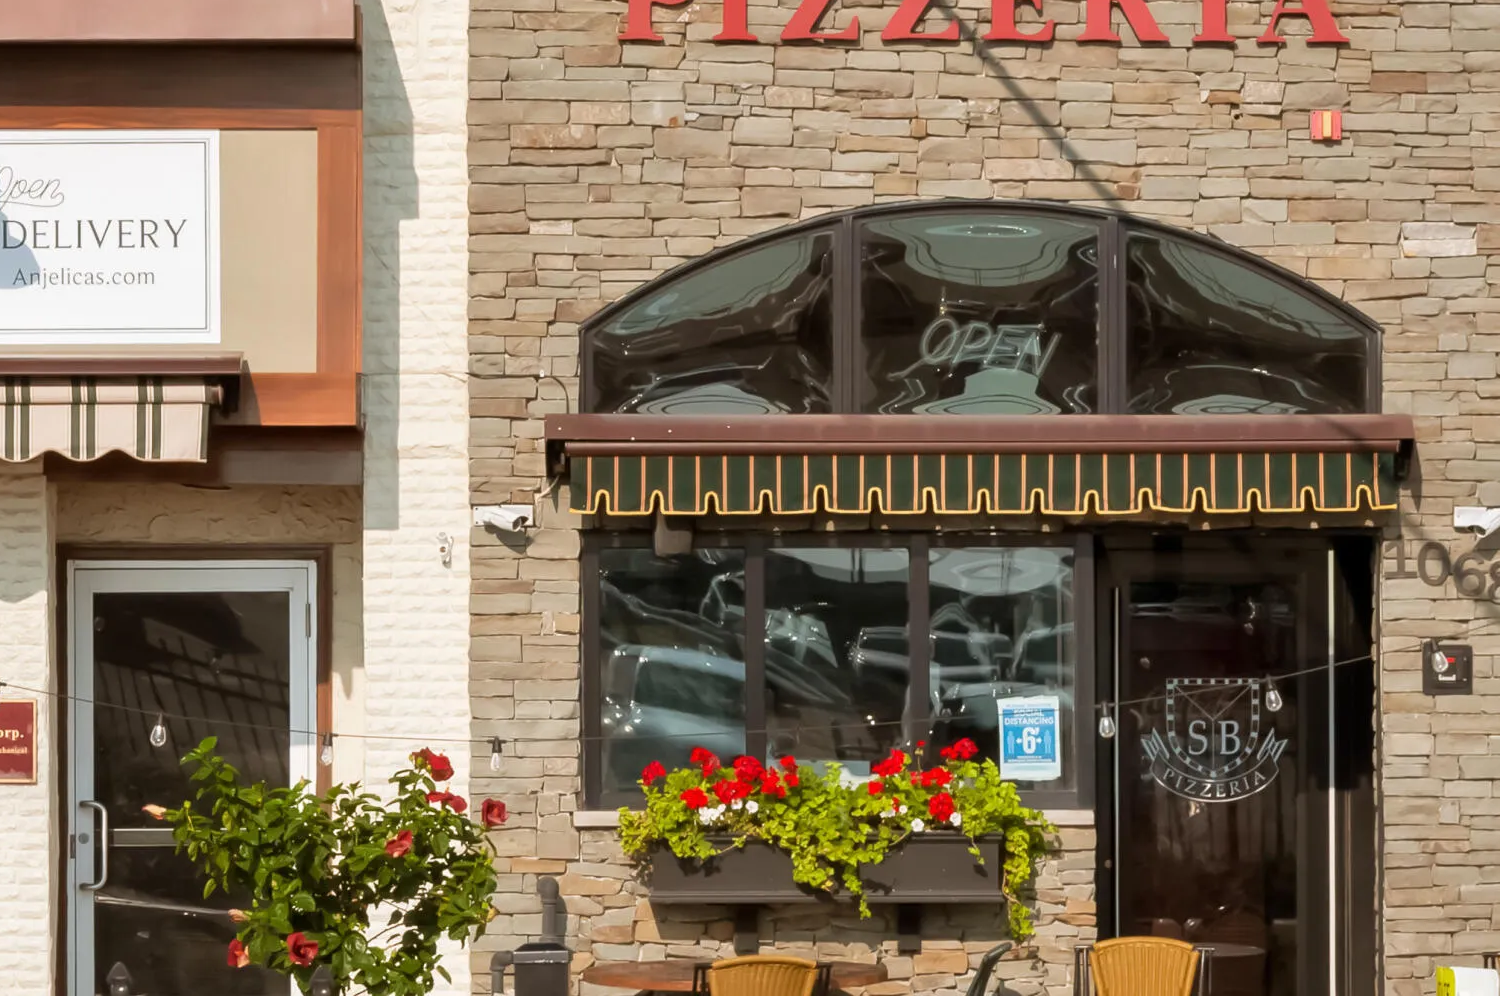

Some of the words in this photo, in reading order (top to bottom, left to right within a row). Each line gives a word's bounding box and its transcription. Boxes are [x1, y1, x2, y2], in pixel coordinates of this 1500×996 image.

[1, 218, 189, 250] DELIVERY
[11, 267, 156, 290] Anjelicas.com
[920, 317, 1063, 378] OPEN
[1162, 767, 1267, 798] PIZZERIA
